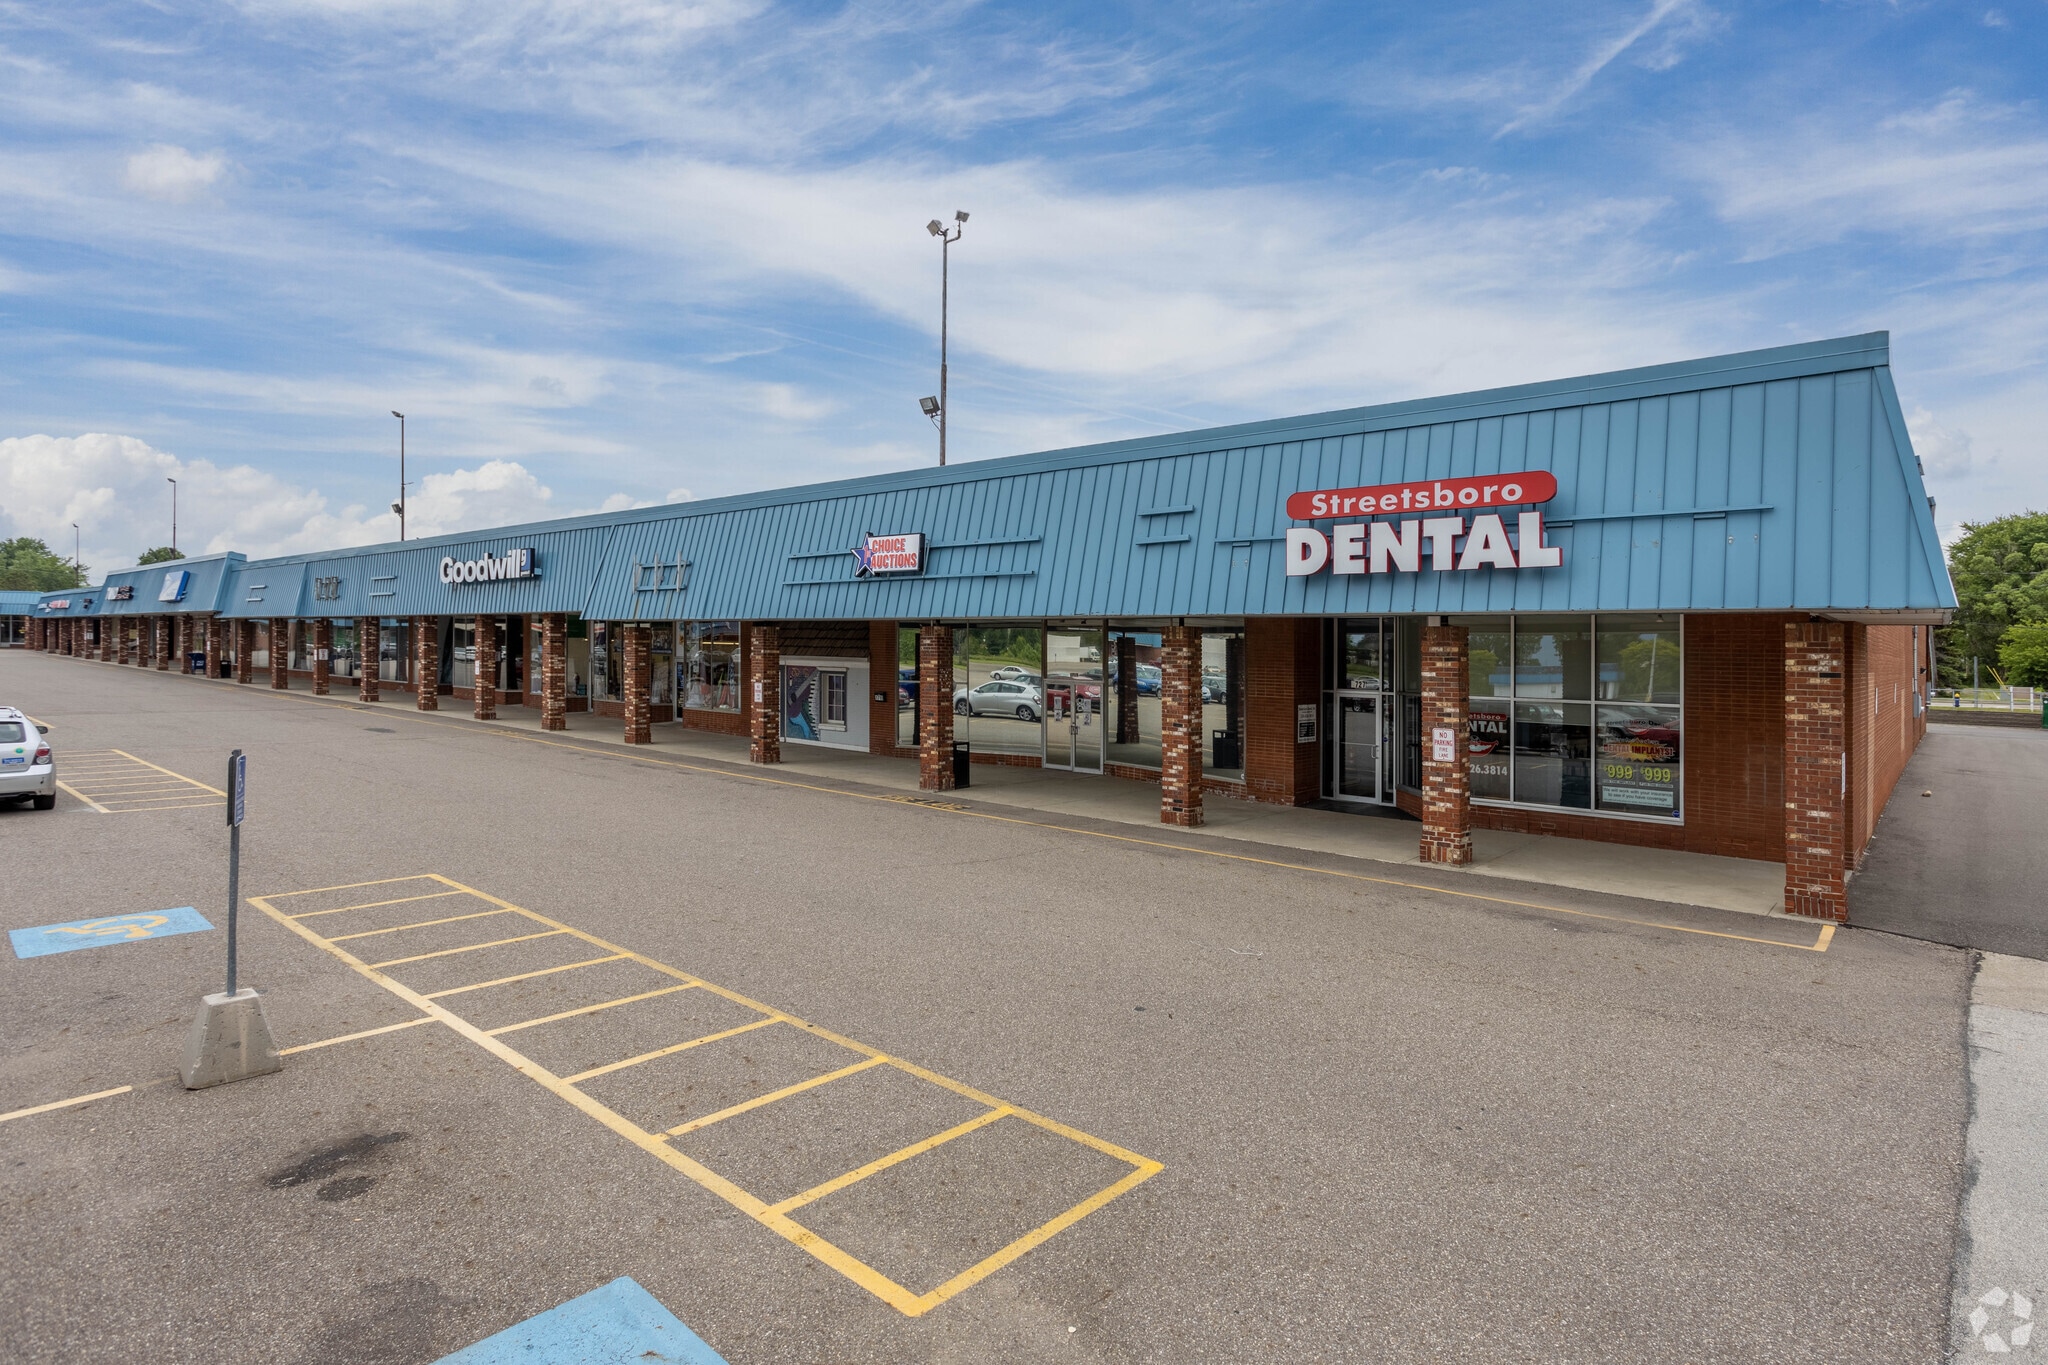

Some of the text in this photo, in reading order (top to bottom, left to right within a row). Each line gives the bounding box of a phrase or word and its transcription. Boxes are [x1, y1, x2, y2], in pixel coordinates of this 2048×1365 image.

[1311, 483, 1523, 516] Streetsboro
[872, 538, 906, 553] CHOICE
[1286, 511, 1563, 576] DENTAL
[440, 549, 521, 584] Goodwill
[871, 553, 917, 569] AUCTIONS
[1469, 721, 1507, 733] NTAL
[1631, 745, 1673, 756] IMPLANTS!
[1470, 763, 1508, 776] 26.3814
